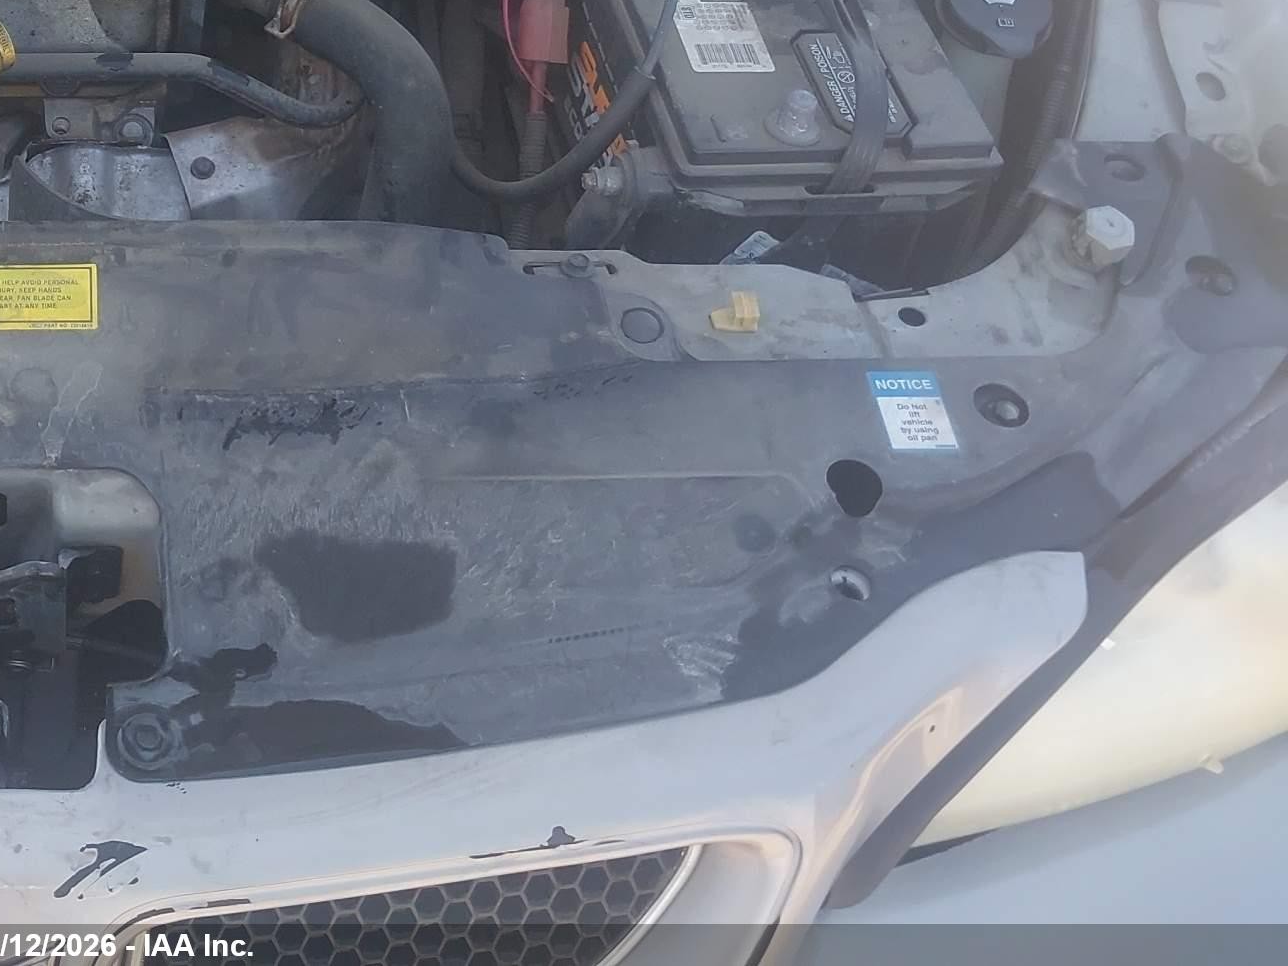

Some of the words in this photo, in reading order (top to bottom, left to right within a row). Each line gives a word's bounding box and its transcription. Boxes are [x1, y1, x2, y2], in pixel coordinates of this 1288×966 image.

[808, 44, 830, 73] POISON
[827, 80, 851, 114] DANGER
[874, 379, 934, 390] NOTICE
[901, 418, 934, 426] vehicle
[900, 427, 912, 435] by
[913, 426, 940, 435] using
